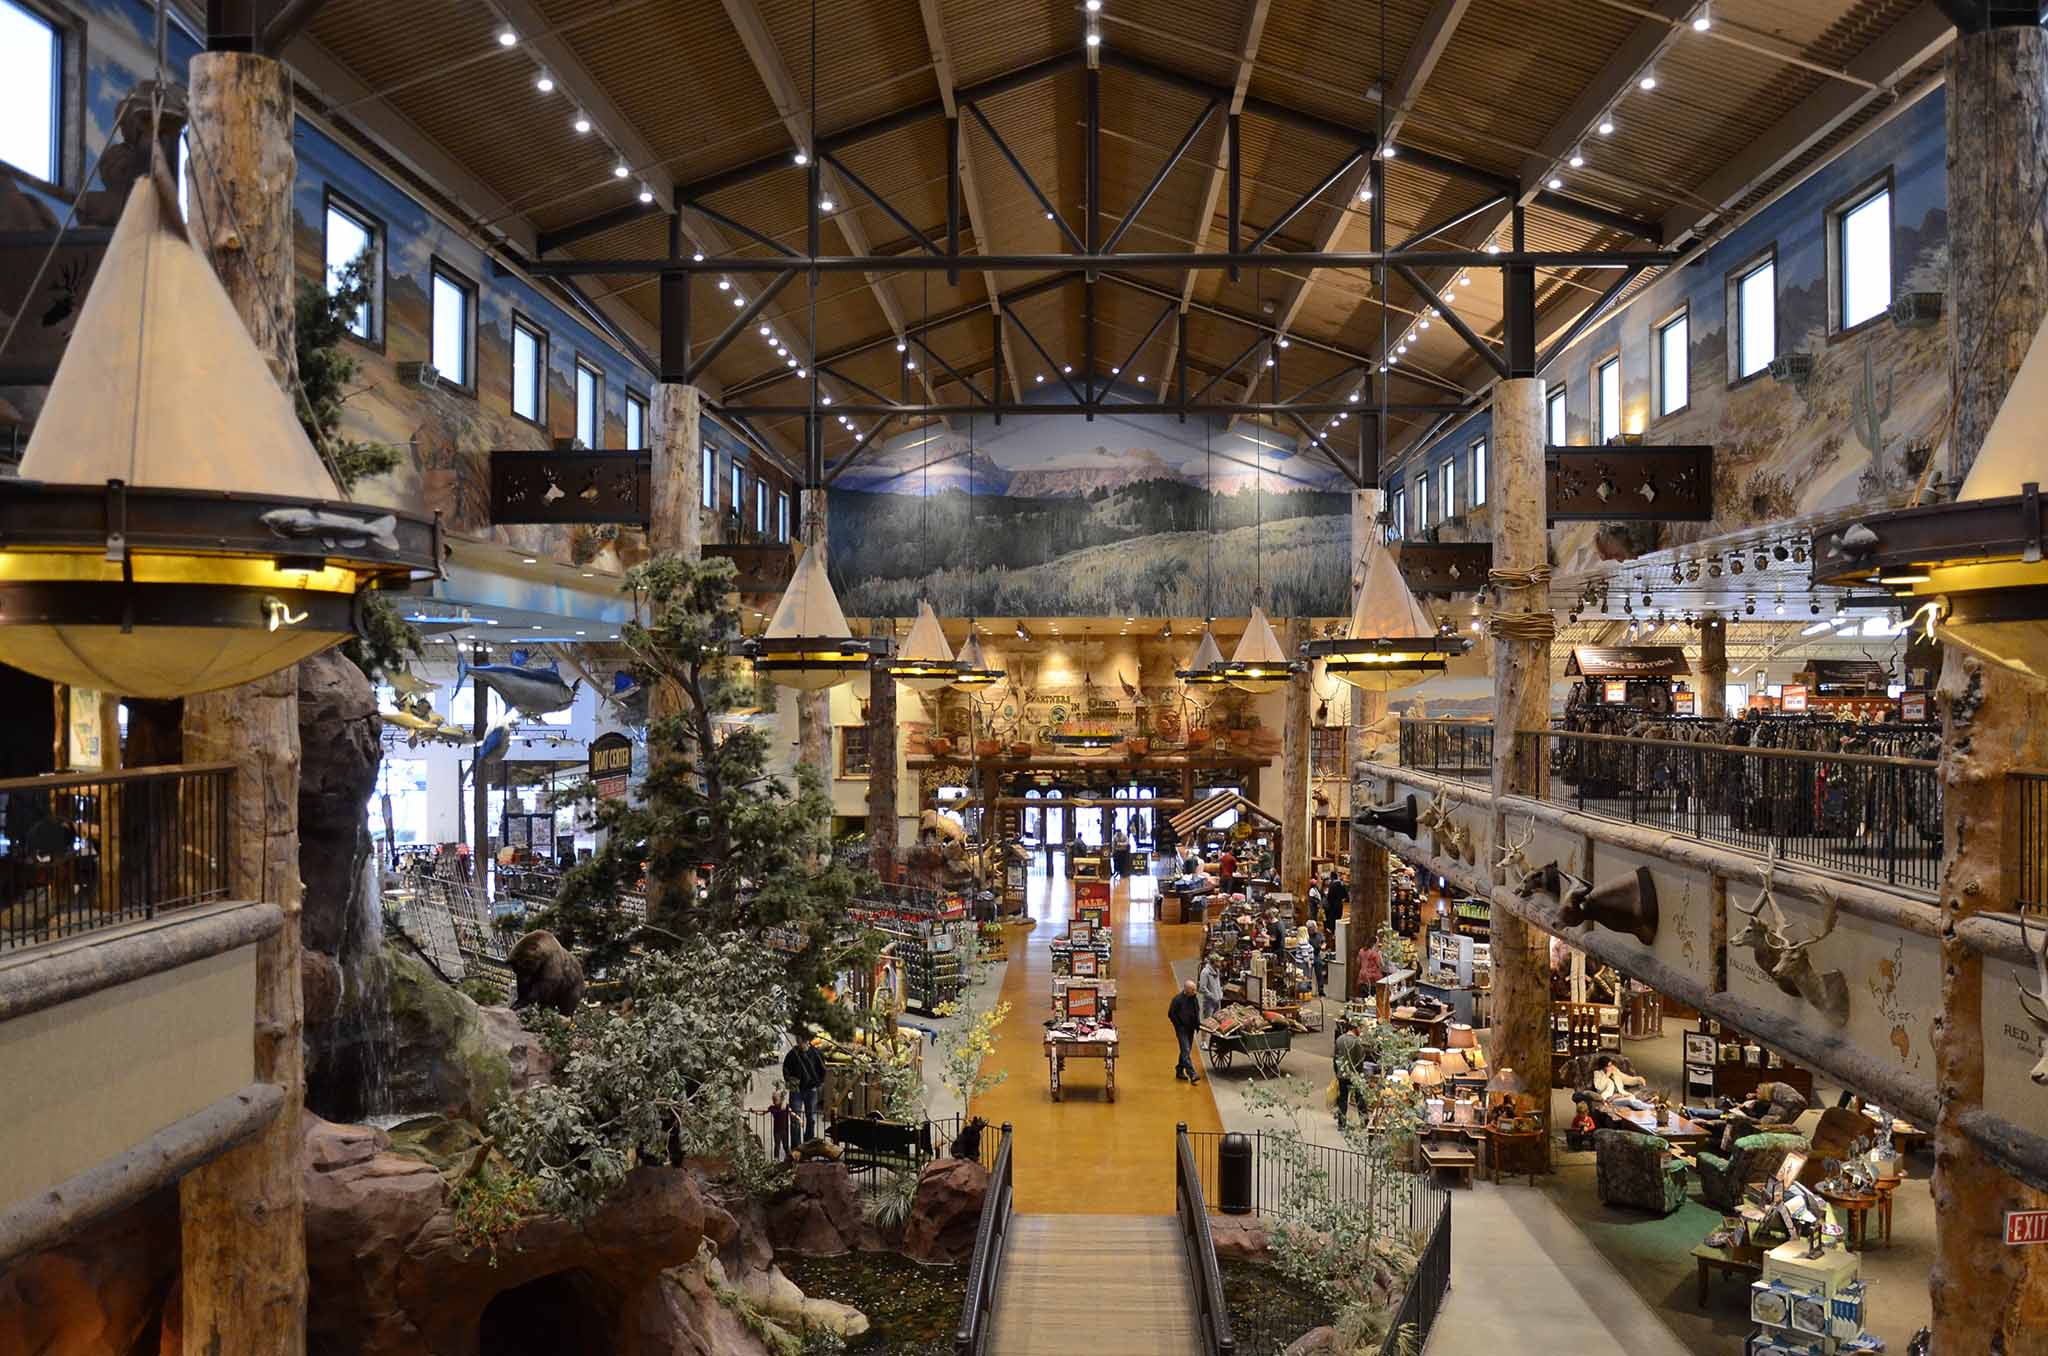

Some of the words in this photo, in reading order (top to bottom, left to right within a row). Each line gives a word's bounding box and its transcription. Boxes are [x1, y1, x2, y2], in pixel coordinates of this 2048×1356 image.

[1626, 656, 1675, 670] STATION
[594, 750, 609, 772] BOAT
[609, 747, 629, 769] CENTER
[2003, 1023, 2030, 1042] RED
[2013, 1215, 2048, 1241] EXIT
